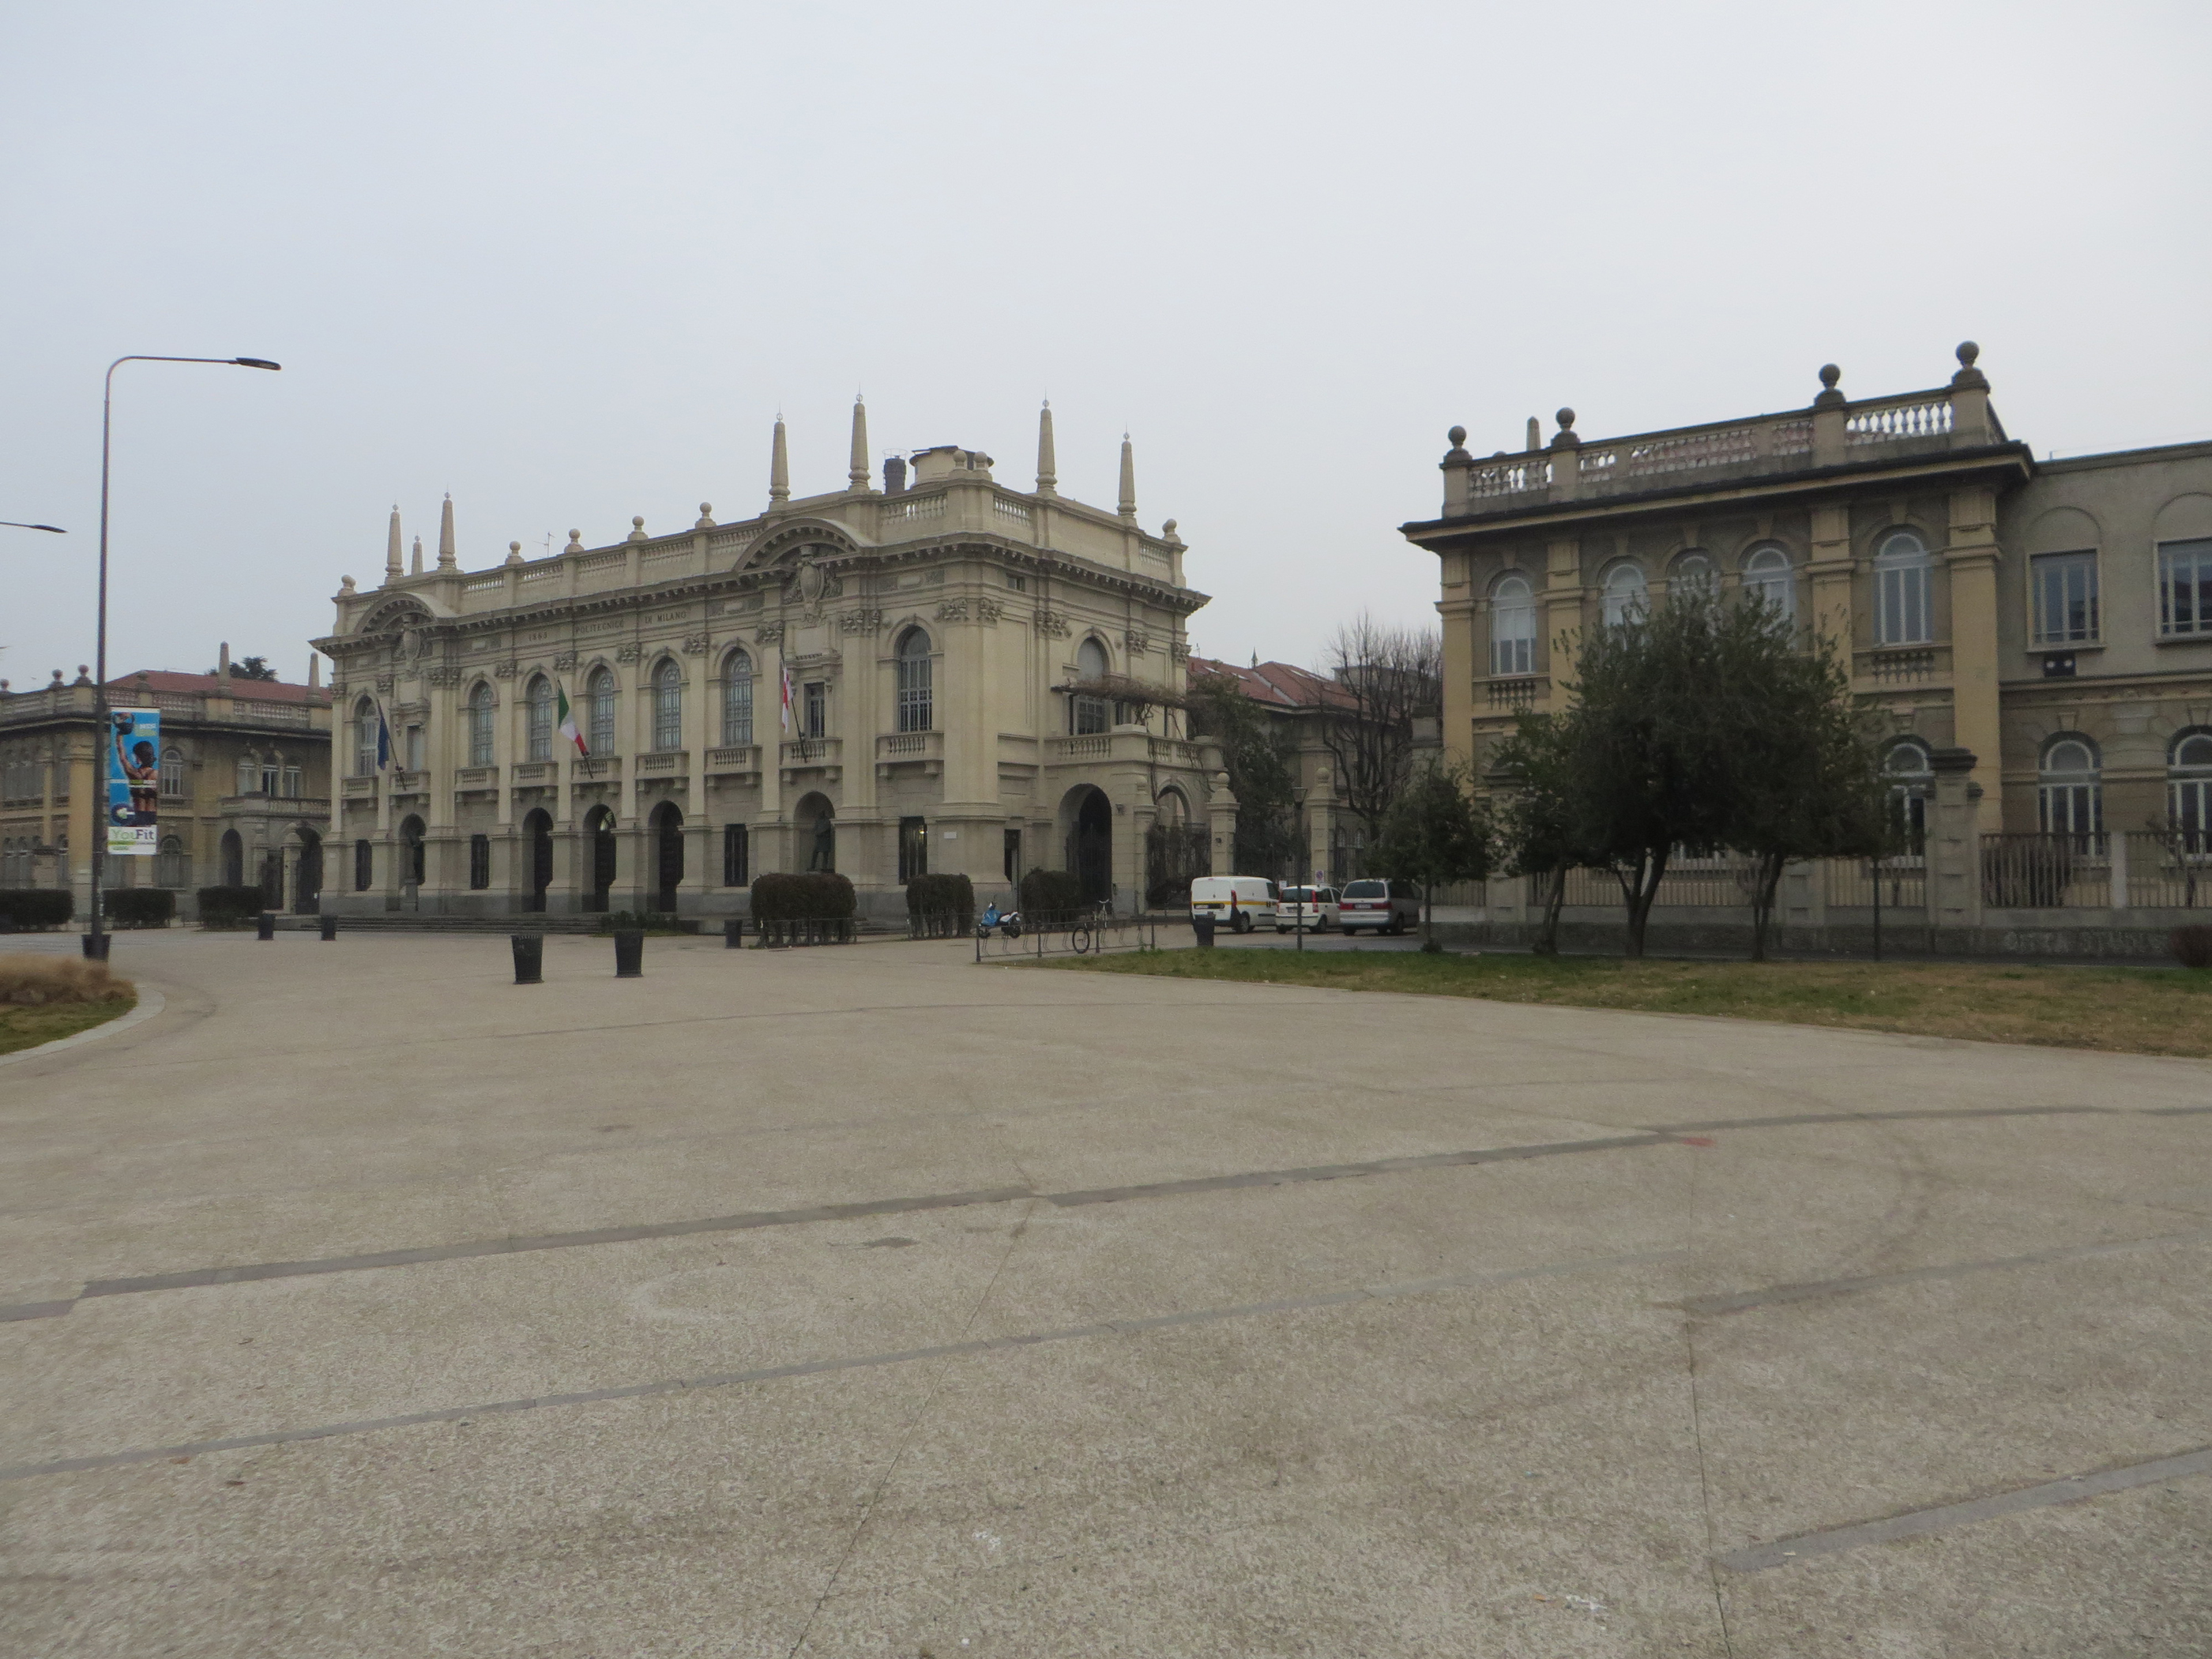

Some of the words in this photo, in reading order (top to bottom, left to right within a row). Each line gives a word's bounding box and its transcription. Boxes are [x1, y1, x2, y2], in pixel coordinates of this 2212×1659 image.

[645, 615, 653, 624] DI
[657, 611, 687, 622] MILANO
[111, 829, 155, 840] YouFit
